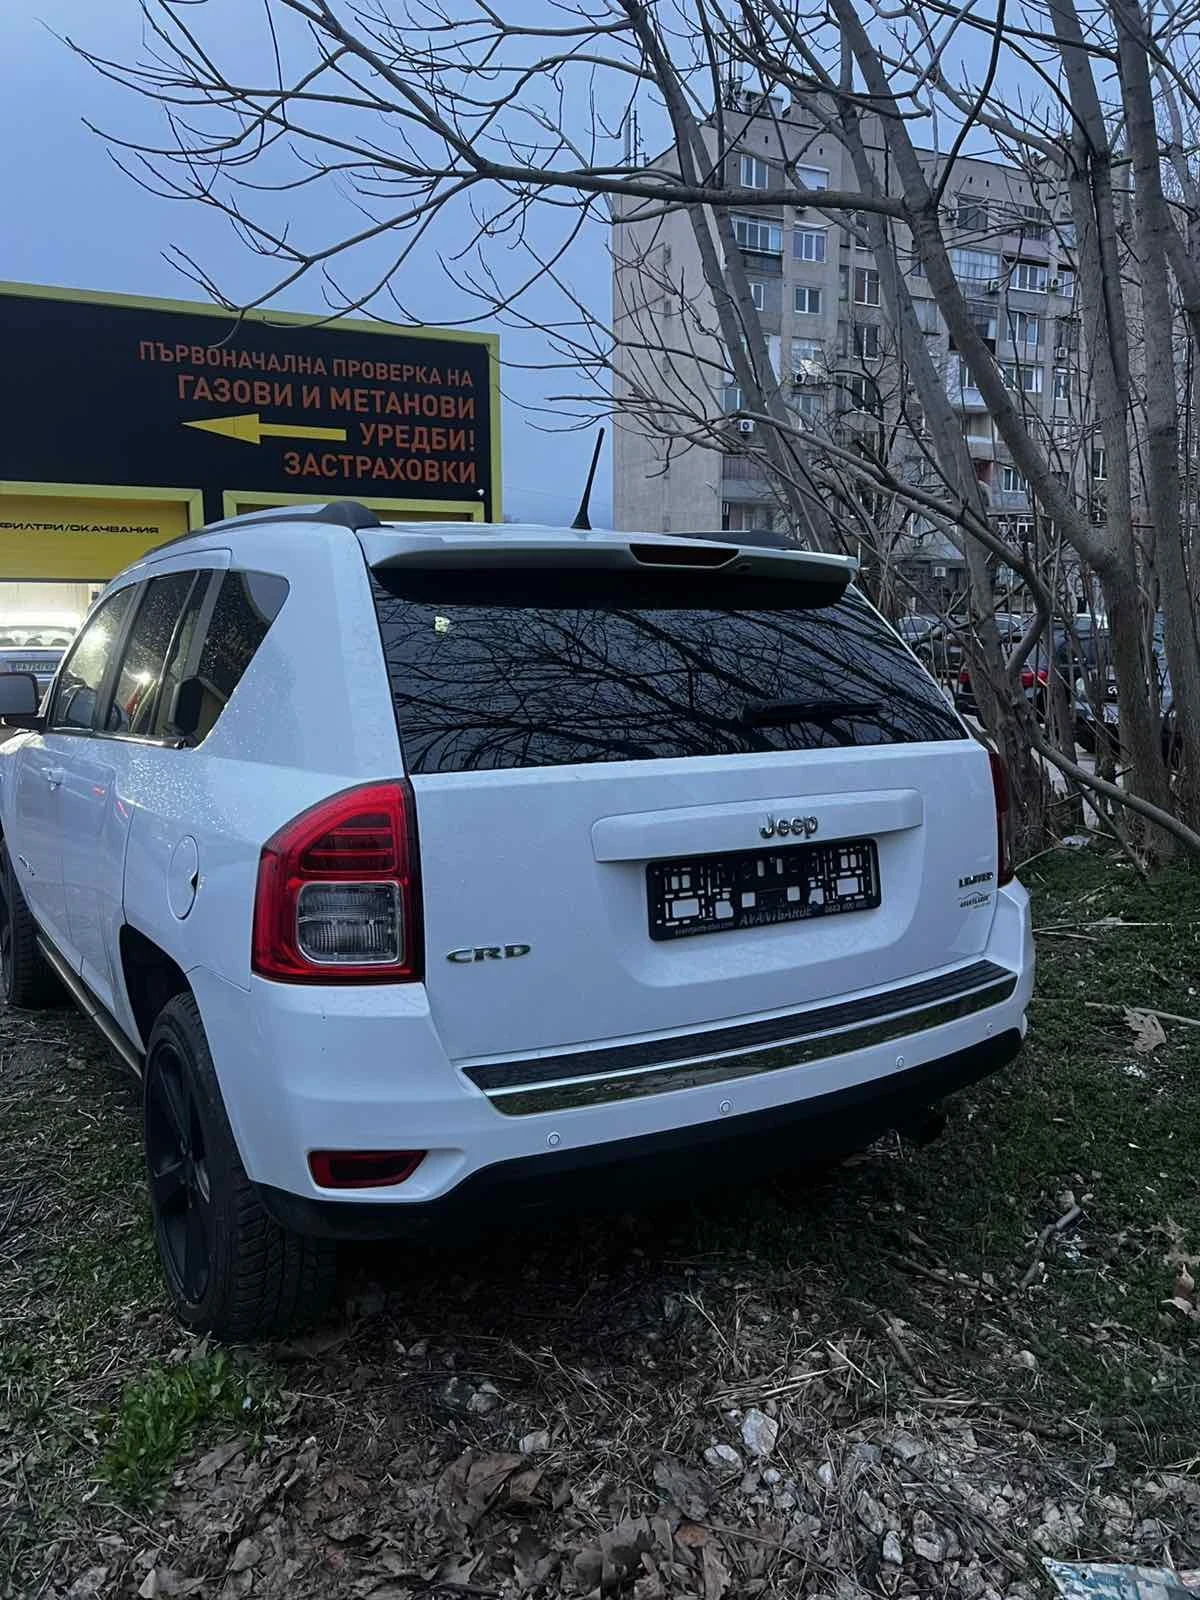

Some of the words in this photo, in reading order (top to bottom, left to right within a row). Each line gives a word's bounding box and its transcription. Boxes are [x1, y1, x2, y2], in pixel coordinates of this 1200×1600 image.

[139, 340, 328, 376] ПЪРВОНАЧАЛНА
[332, 358, 442, 386] ПРОВЕРКА
[447, 369, 473, 388] НА
[177, 374, 293, 408] ГАЗОВИ
[301, 384, 321, 410] И
[330, 386, 476, 420] МЕТАНОВИ
[359, 422, 476, 454] УРЕДБИ!
[284, 451, 477, 484] ЗАСТРАХОВКИ
[760, 812, 819, 840] Jeep
[446, 943, 531, 964] CRD
